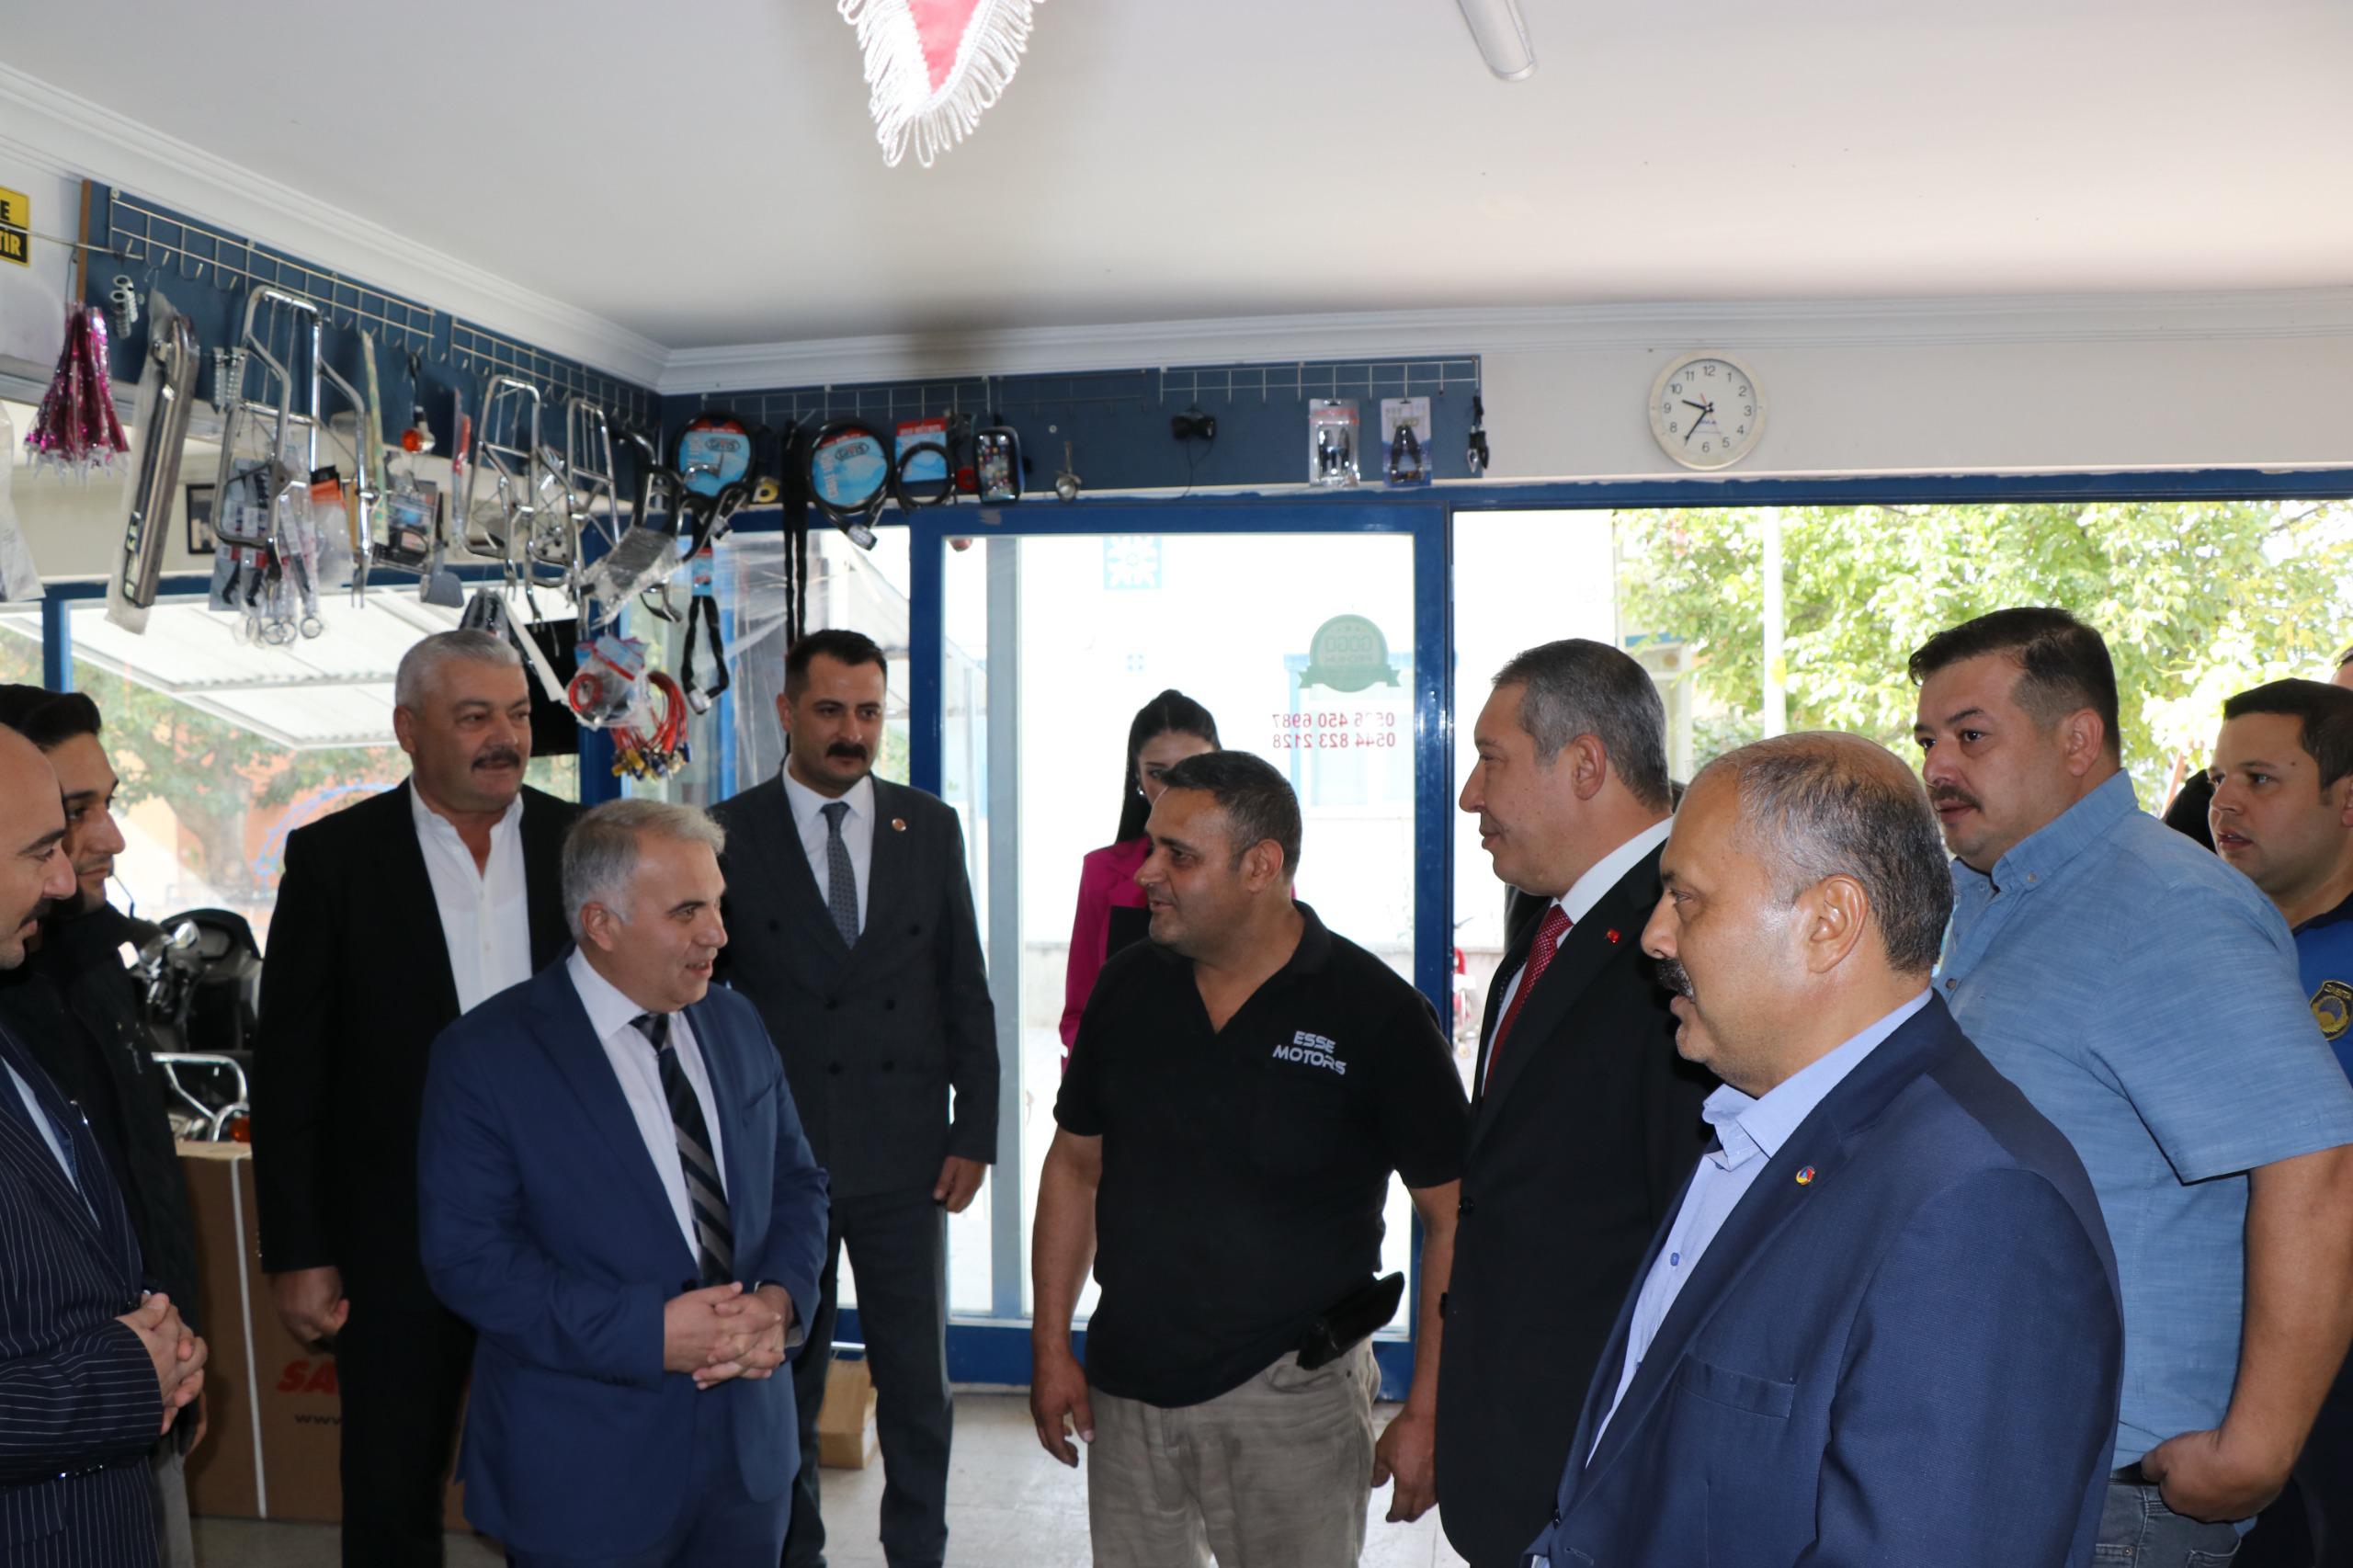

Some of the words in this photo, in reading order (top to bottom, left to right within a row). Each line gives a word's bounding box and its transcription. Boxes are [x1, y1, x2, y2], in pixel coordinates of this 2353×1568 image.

[1685, 370, 1695, 381] 11
[1703, 365, 1715, 377] 12
[1727, 372, 1732, 382] 1
[1671, 383, 1683, 394] 10
[1738, 385, 1747, 397] 2
[1664, 403, 1672, 414] 9
[1744, 405, 1752, 416] 3
[1669, 422, 1677, 433] 8
[1736, 425, 1744, 435] 4
[1701, 441, 1710, 452] 6
[1722, 437, 1730, 448] 5
[1293, 1030, 1336, 1054] ESSE
[1272, 1044, 1347, 1075] MOTORS
